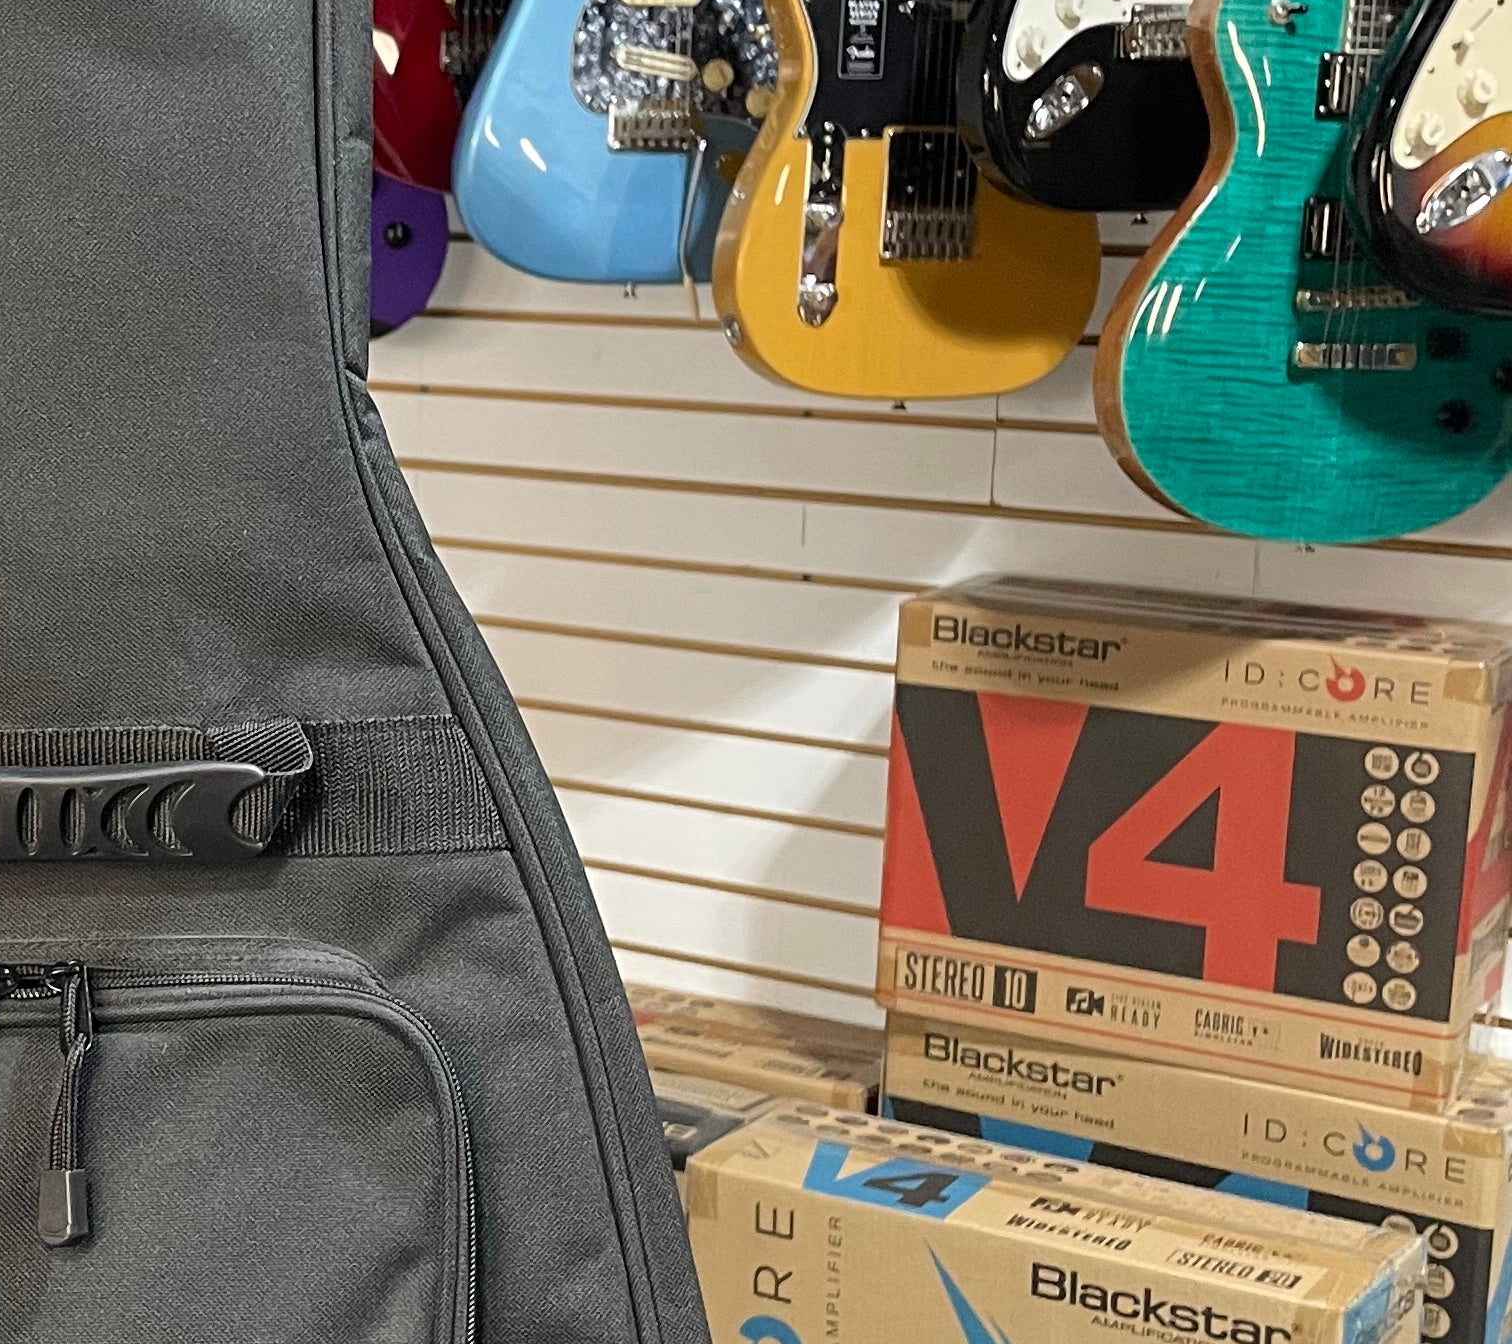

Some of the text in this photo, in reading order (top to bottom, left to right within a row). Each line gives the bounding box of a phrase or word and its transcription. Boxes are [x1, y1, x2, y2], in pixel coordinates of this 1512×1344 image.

[932, 613, 1122, 662] Blackstar
[904, 951, 1028, 1008] STEREO 10
[923, 1032, 1116, 1096] Blackstar
